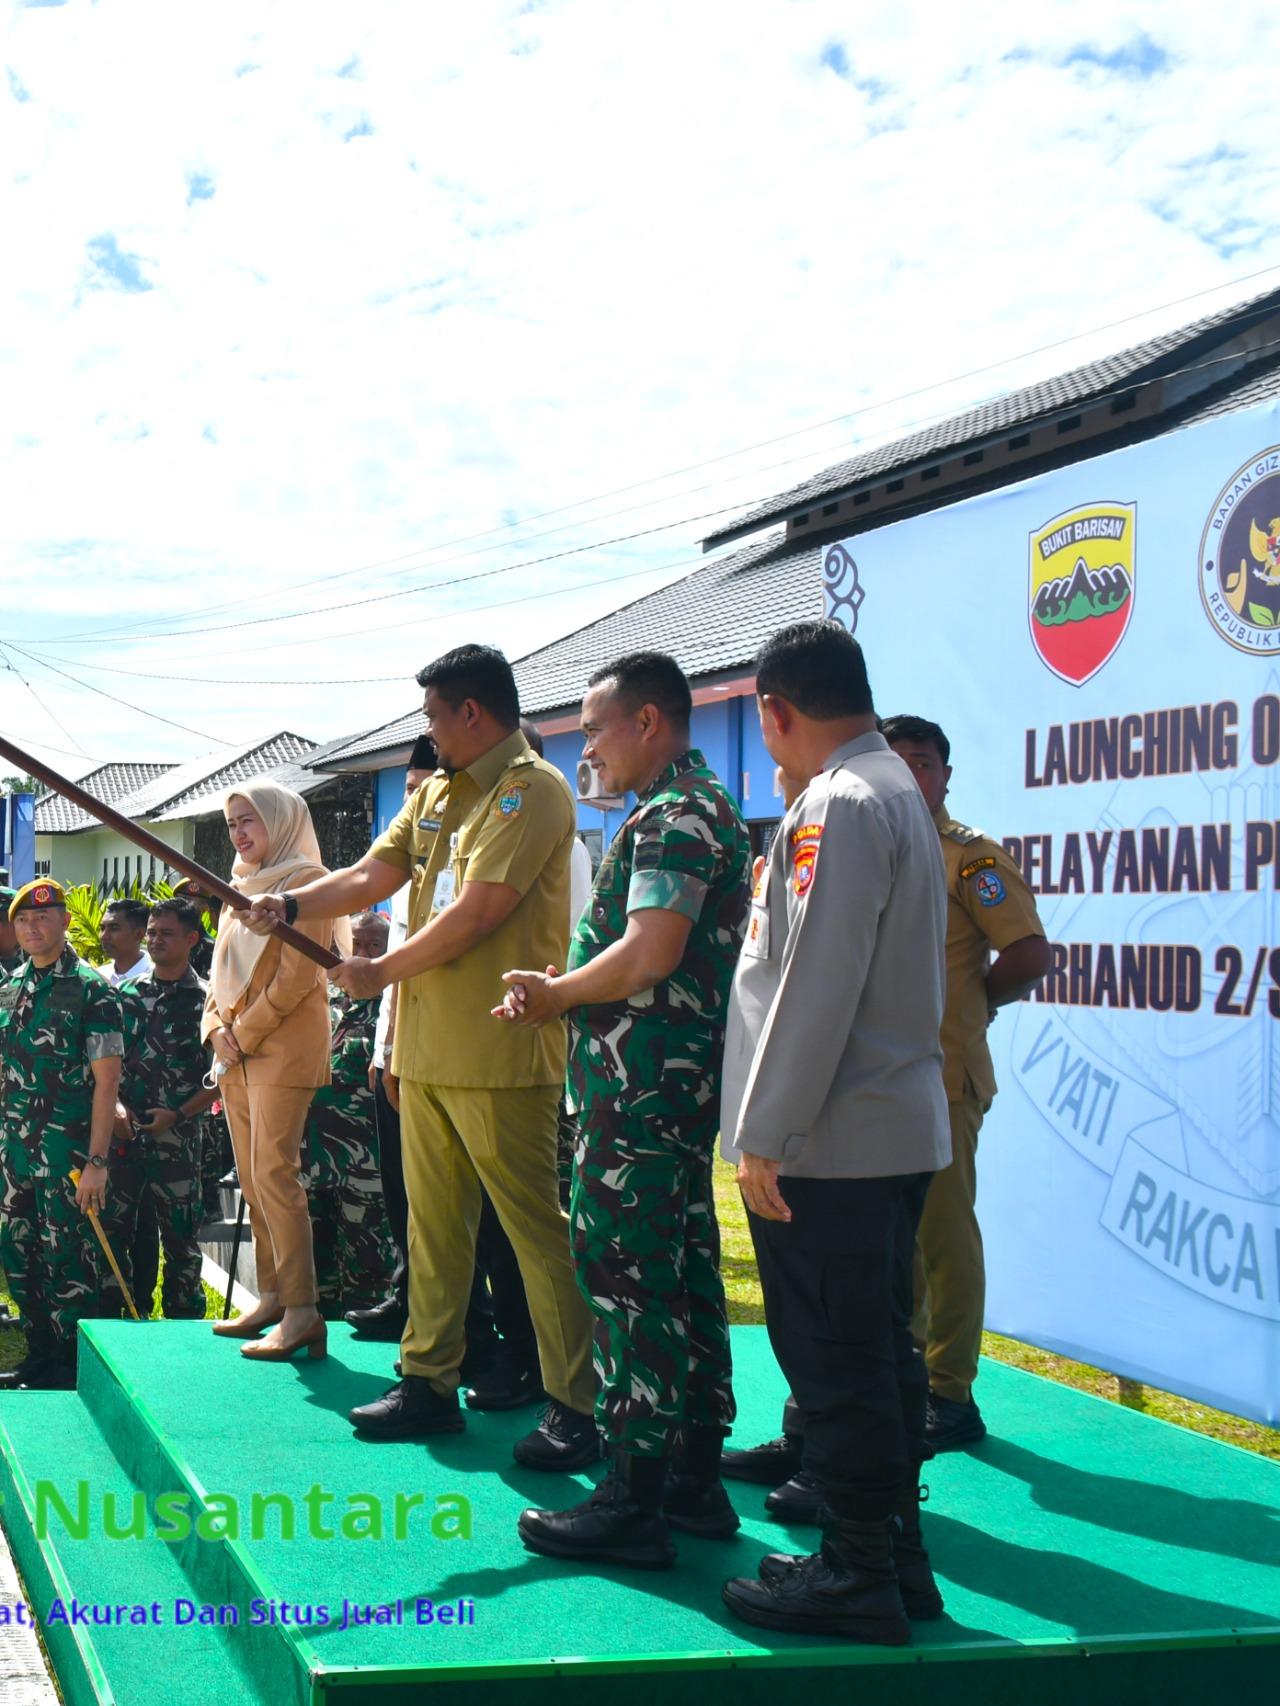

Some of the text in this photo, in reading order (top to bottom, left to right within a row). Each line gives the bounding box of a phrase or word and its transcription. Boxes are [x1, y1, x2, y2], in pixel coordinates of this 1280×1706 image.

[1213, 473, 1253, 530] BADAN
[1041, 518, 1124, 557] BUKIT BARISAN
[1209, 591, 1272, 646] REPUBLIK
[1024, 700, 1239, 789] LAUNCHING
[1021, 942, 1202, 1013] RHANUD
[1120, 1170, 1264, 1301] RAKCA
